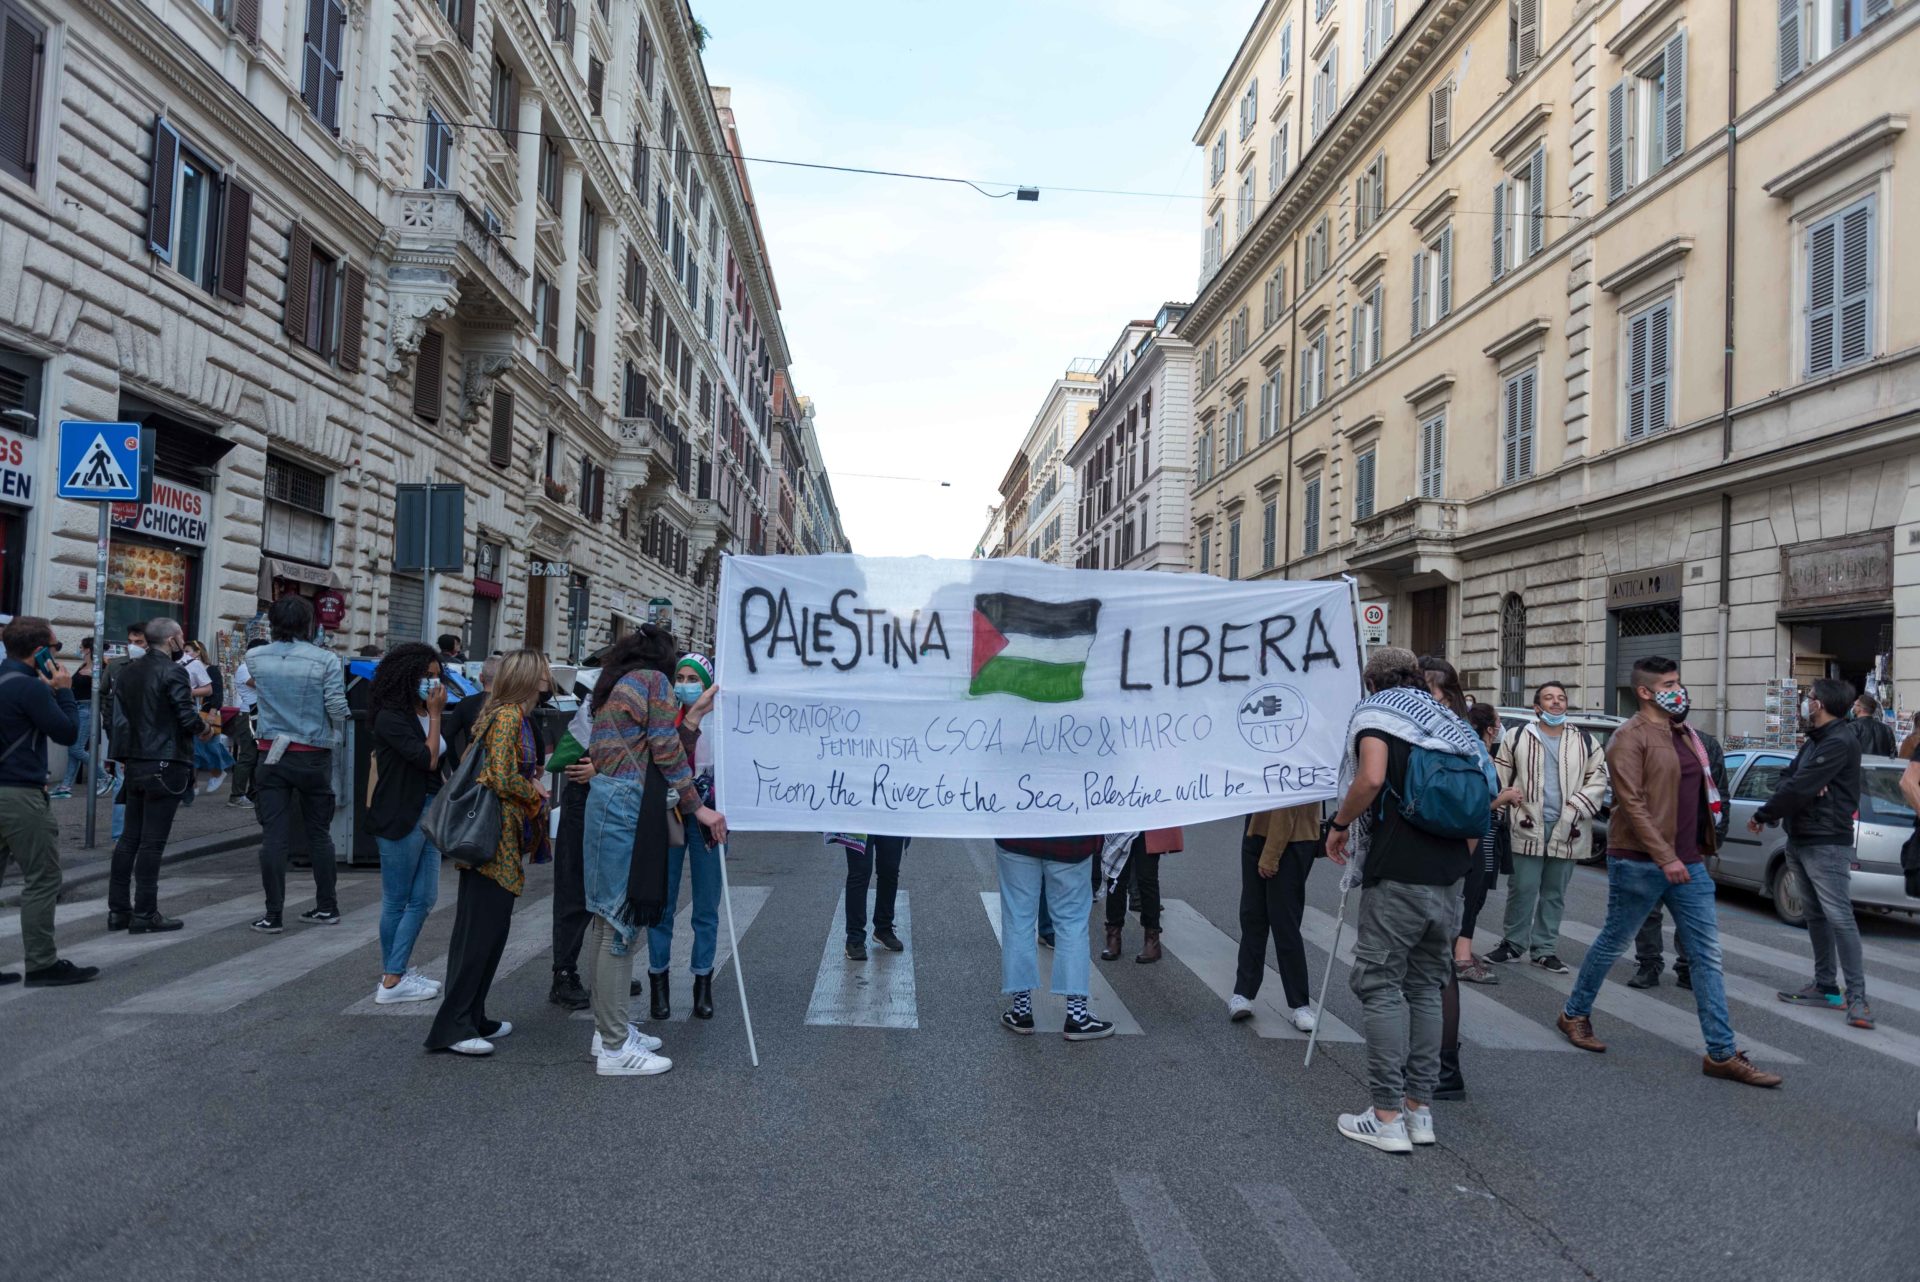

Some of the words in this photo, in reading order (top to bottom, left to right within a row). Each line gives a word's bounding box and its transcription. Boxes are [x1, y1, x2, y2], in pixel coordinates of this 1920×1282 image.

[0, 468, 31, 499] EN
[153, 483, 202, 516] WINGS
[143, 507, 207, 541] CHICKEN
[531, 561, 568, 576] BAR
[1612, 579, 1644, 600] ANTICA
[1368, 611, 1380, 620] 30
[740, 586, 950, 673] PALESTINA
[1120, 607, 1341, 690] LIBERA
[817, 735, 923, 763] FEMMINISTA
[925, 716, 1003, 755] CSOA
[1250, 723, 1296, 745] CITY
[753, 759, 825, 810] From
[827, 769, 862, 806] the
[872, 763, 935, 810] River
[936, 774, 957, 806] to
[960, 777, 1006, 813] the
[1016, 774, 1079, 814] Sea,
[1083, 771, 1172, 811] Palestine
[1176, 772, 1212, 801] will
[1224, 770, 1252, 797] be
